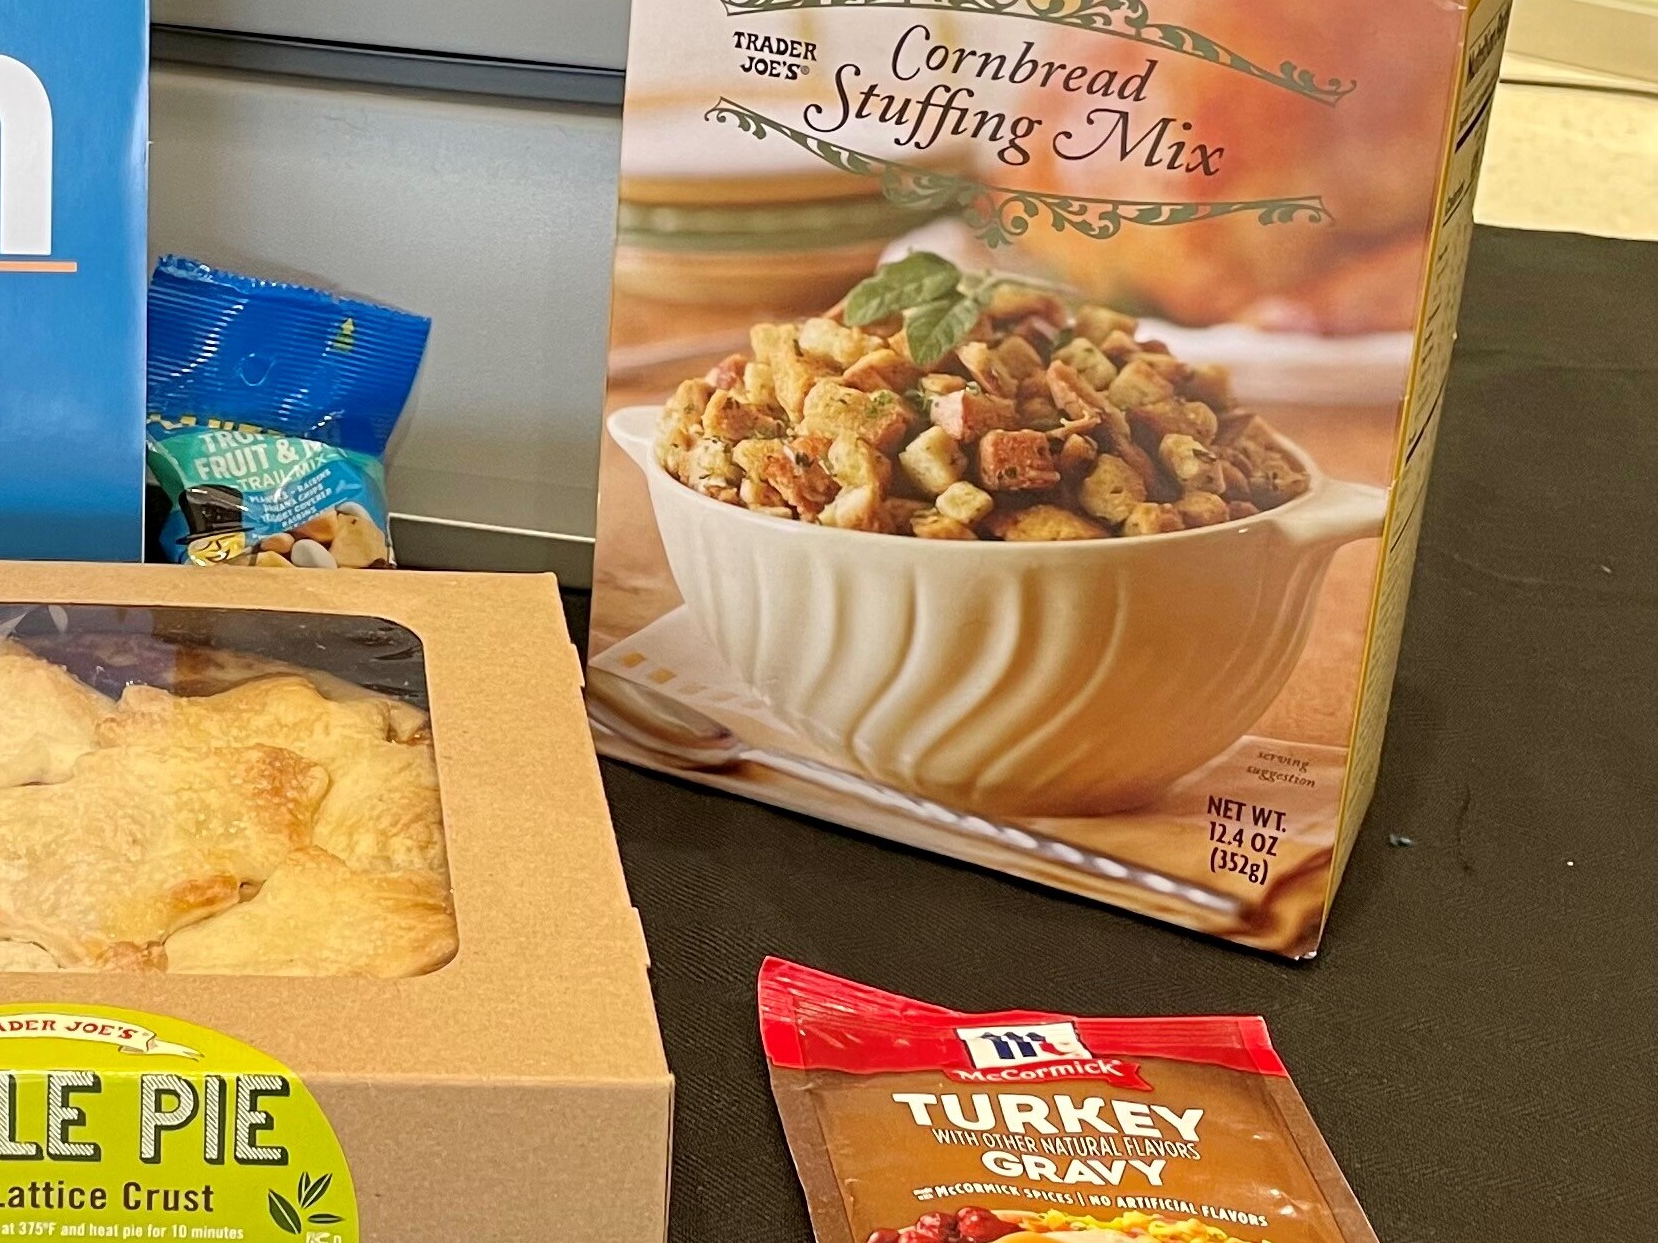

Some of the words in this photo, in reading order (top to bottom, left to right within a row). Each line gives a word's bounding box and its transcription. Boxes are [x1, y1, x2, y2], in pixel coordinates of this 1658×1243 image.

[732, 31, 817, 62] TRADER
[891, 24, 1158, 102] Cornbread
[803, 63, 1042, 166] Stuffing
[1052, 107, 1226, 177] Mix
[194, 443, 270, 481] FRUIT
[275, 438, 299, 464] &
[294, 453, 327, 478] MIX
[1246, 765, 1316, 788] suggestion
[1257, 751, 1310, 773] serving
[1207, 794, 1246, 821] NET
[1251, 805, 1287, 832] WT.
[1209, 821, 1244, 848] 12.4
[1250, 832, 1279, 856] OZ
[1210, 847, 1268, 885] (352g)
[952, 1059, 1124, 1082] McCormick
[138, 1073, 291, 1165] PIE
[892, 1093, 1204, 1143] TURKEY
[931, 1128, 979, 1147] WITH
[982, 1132, 1038, 1154] OTHER
[1041, 1136, 1122, 1158] NATURAL
[1124, 1136, 1202, 1161] FLAVORS
[981, 1150, 1167, 1187] GRAVY
[123, 1182, 215, 1213] Crust
[1024, 1188, 1074, 1205] SPICES
[1088, 1194, 1112, 1207] NO
[1116, 1196, 1198, 1215] ARTIFICIAL
[1201, 1205, 1269, 1227] FLAVORS
[2, 1222, 15, 1235] at
[60, 1222, 85, 1236] and
[89, 1223, 119, 1237] heat
[123, 1224, 142, 1240] pie
[147, 1224, 166, 1238] for
[172, 1225, 187, 1238] 10
[191, 1225, 244, 1240] minutes
